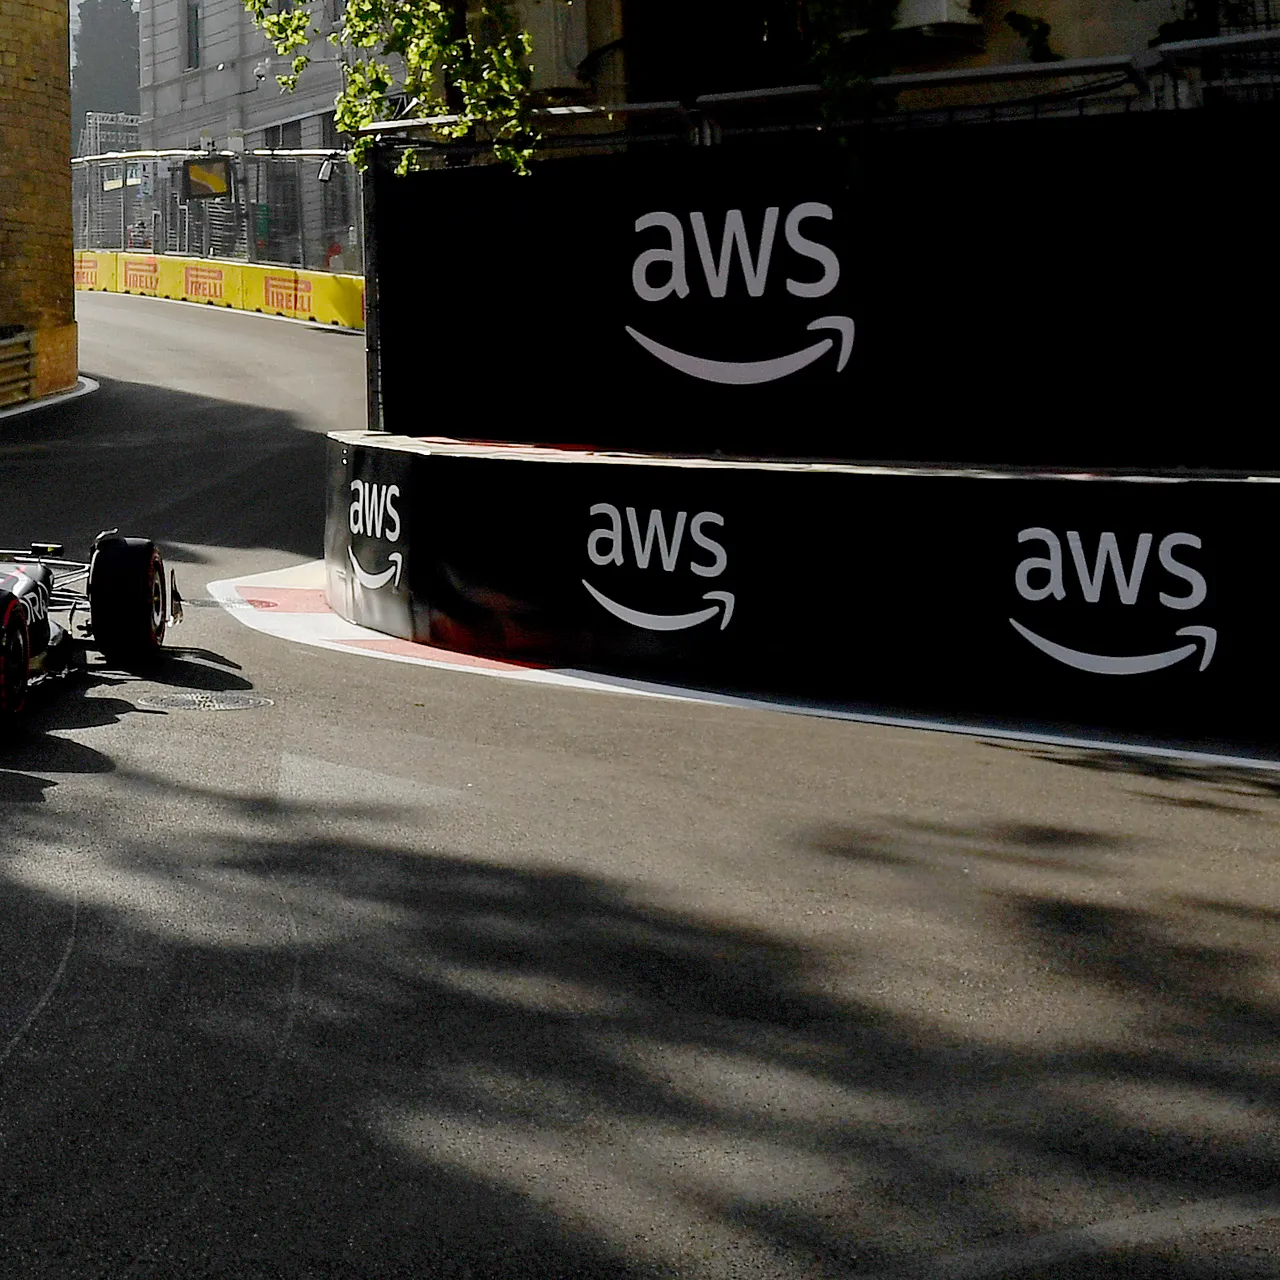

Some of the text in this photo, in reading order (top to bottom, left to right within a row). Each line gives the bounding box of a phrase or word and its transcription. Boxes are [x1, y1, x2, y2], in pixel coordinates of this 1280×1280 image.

[185, 266, 223, 298] PIRELLI
[631, 201, 841, 302] aws
[264, 276, 312, 313] PIRELLI
[349, 479, 401, 542] aws
[586, 502, 728, 578] aws
[1014, 526, 1208, 611] aws
